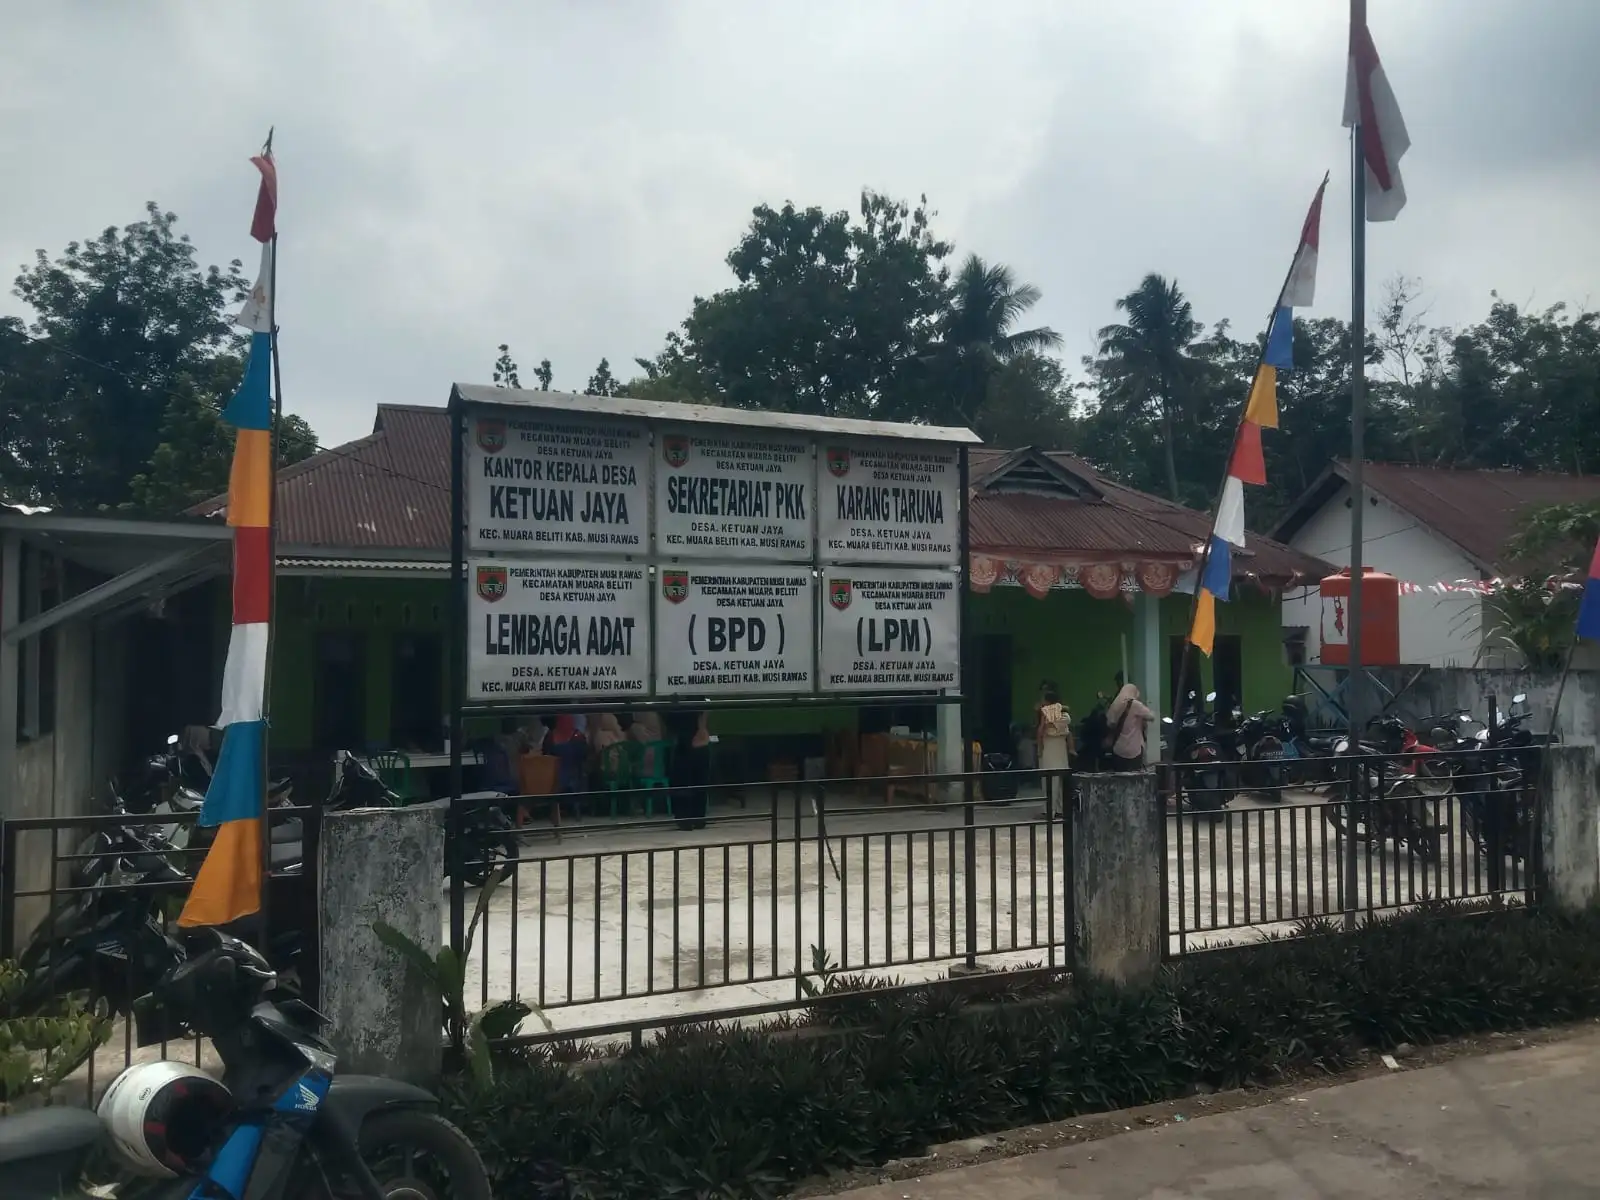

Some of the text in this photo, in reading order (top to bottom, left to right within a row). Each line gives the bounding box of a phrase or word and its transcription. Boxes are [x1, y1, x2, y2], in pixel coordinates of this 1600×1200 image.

[521, 432, 571, 444] KECAMATAN
[574, 435, 600, 447] MUARA
[538, 447, 613, 460] DESA KETUAN JAYA
[484, 457, 637, 486] KANTOR KEPALA DESA
[717, 461, 782, 473] DESA KETUAN JAYA
[874, 471, 932, 483] DESA KETUAN JAYA
[668, 476, 805, 520] SEKRETARIAT PKK
[490, 485, 629, 525] KETUAN JAYA
[837, 485, 944, 524] KARANG TARUNA
[692, 522, 784, 535] DESA. KETUAN JAYA
[851, 528, 932, 540] DESA. KETUAN JAYA
[480, 528, 639, 545] KEC. MUARA BELITI KAB. MUSI RAWAS
[667, 535, 805, 549] KEC. MUARA BELITI KAB. MUSI RAWAS
[829, 540, 951, 553] KEC. MUARA BELITI KAB. MUSI RAWAS
[510, 568, 642, 580] PEMERINTAH KABUPATEN MUSI RAWAS
[522, 580, 632, 590] KECAMATAN MUARA BELITI
[691, 576, 731, 585] PEMERINTAH
[732, 577, 769, 586] KABUPATEN
[786, 578, 807, 586] RAWAS
[540, 592, 616, 602] DESA KETUAN JAYA
[702, 587, 798, 596] KECAMATAN MUARA BELITI
[862, 591, 945, 600] KECAMATAN MUARA BELITI
[717, 598, 784, 608] DESA KETUAN JAYA
[875, 602, 932, 610] DESA KETUAN JAYA
[486, 614, 635, 656] LEMBAGA ADAT
[512, 666, 617, 677] DESA. KETUAN JAYA
[694, 660, 785, 671] DESA. KETUAN JAYA
[853, 661, 935, 671] DESA. KETUAN JAYA
[668, 672, 807, 686] KEC. MUARA BELITI KAB. MUSI RAWAS
[831, 675, 846, 684] KEC.
[848, 675, 872, 683] MUARA
[874, 674, 894, 683] BELITI
[914, 674, 931, 682] MUSI
[932, 673, 953, 682] RAWAS
[482, 680, 642, 692] KEC. MUARA BELITI KAB. MUSI RAWAS
